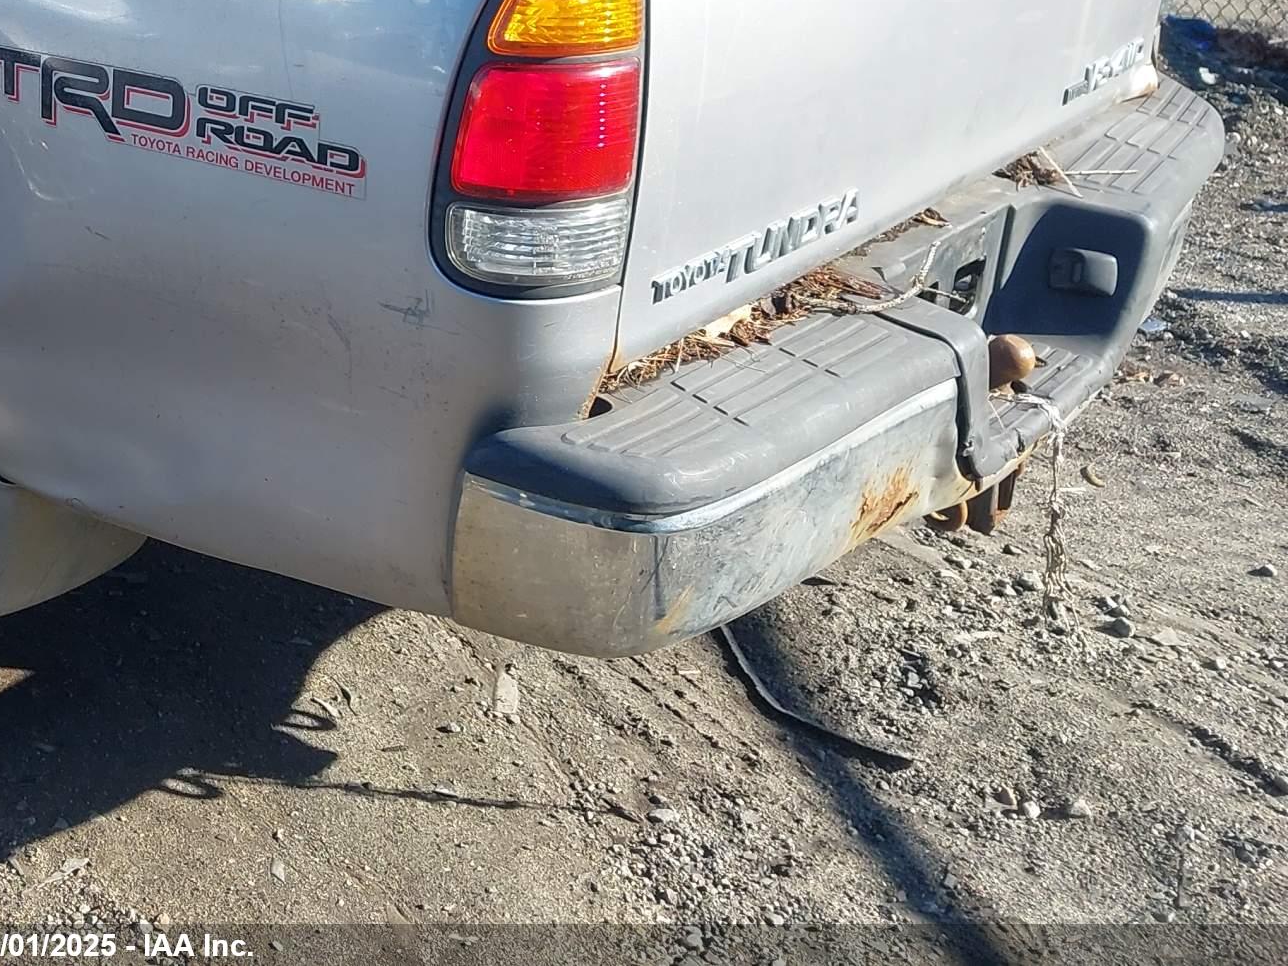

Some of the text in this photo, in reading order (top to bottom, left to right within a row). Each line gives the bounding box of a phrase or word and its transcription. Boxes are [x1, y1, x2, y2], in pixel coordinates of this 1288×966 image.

[197, 86, 319, 130] OFF
[131, 134, 356, 195] TOYOTA RACING DEVELOPMENT
[196, 117, 365, 178] ROAD
[651, 187, 859, 304] TOYOTA TUNDRA
